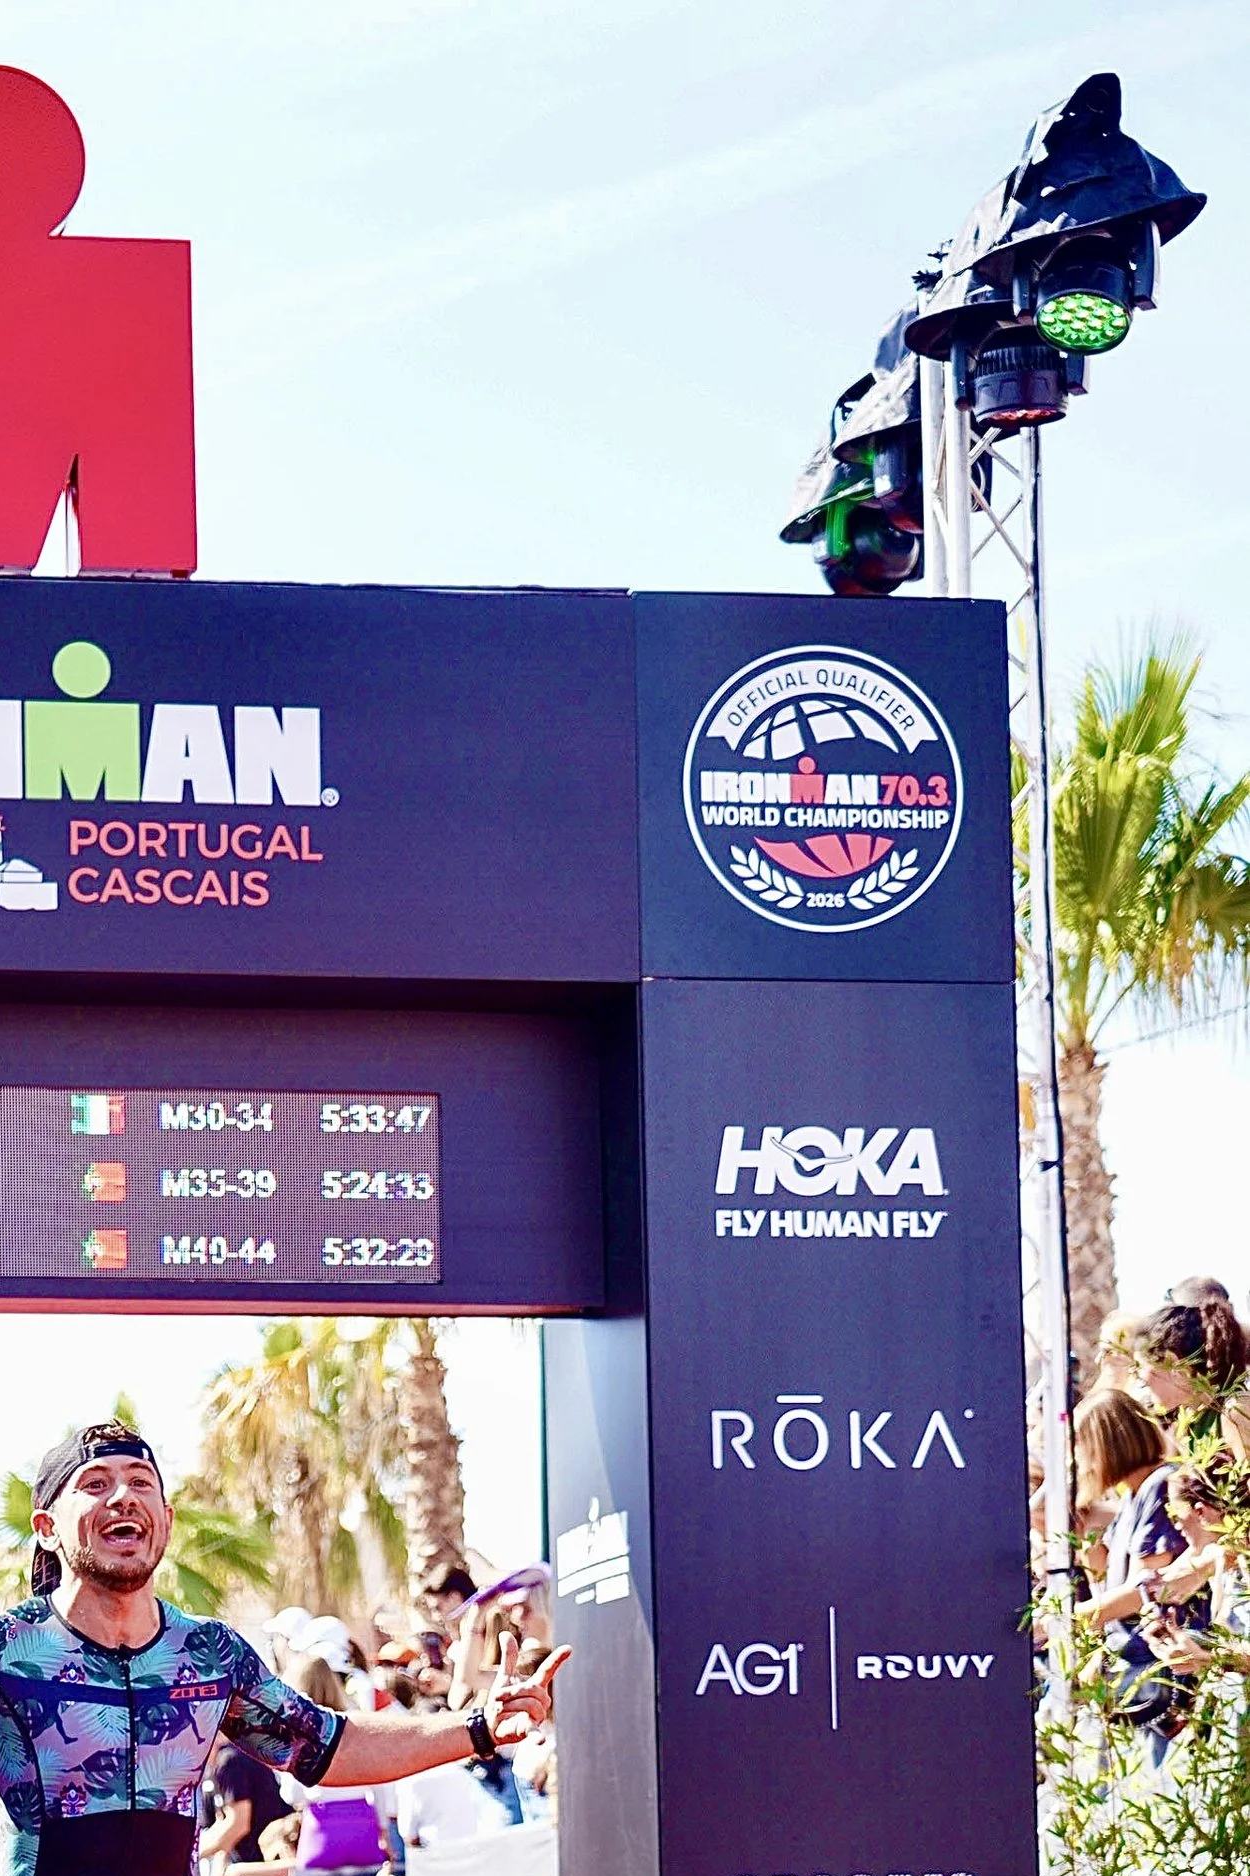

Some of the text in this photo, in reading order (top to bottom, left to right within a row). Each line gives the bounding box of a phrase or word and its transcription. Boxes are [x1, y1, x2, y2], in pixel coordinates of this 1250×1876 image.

[727, 668, 916, 732] OFFICIAL QUALIFIER
[701, 756, 948, 807] IRONMAN 70.3
[701, 805, 949, 829] WORLD CHAMPIONSHIP
[69, 820, 323, 861] PORTUGAL
[68, 867, 270, 906] CASCAIS
[806, 892, 846, 909] 2026
[160, 1102, 273, 1132] M30-34
[320, 1104, 431, 1133] 5:33:47
[715, 1126, 944, 1197] HOKA
[161, 1169, 277, 1198] M35-39
[716, 1209, 943, 1238] FLY HUMAN FLY
[696, 1643, 799, 1695] AG1
[857, 1655, 994, 1679] ROUVY
